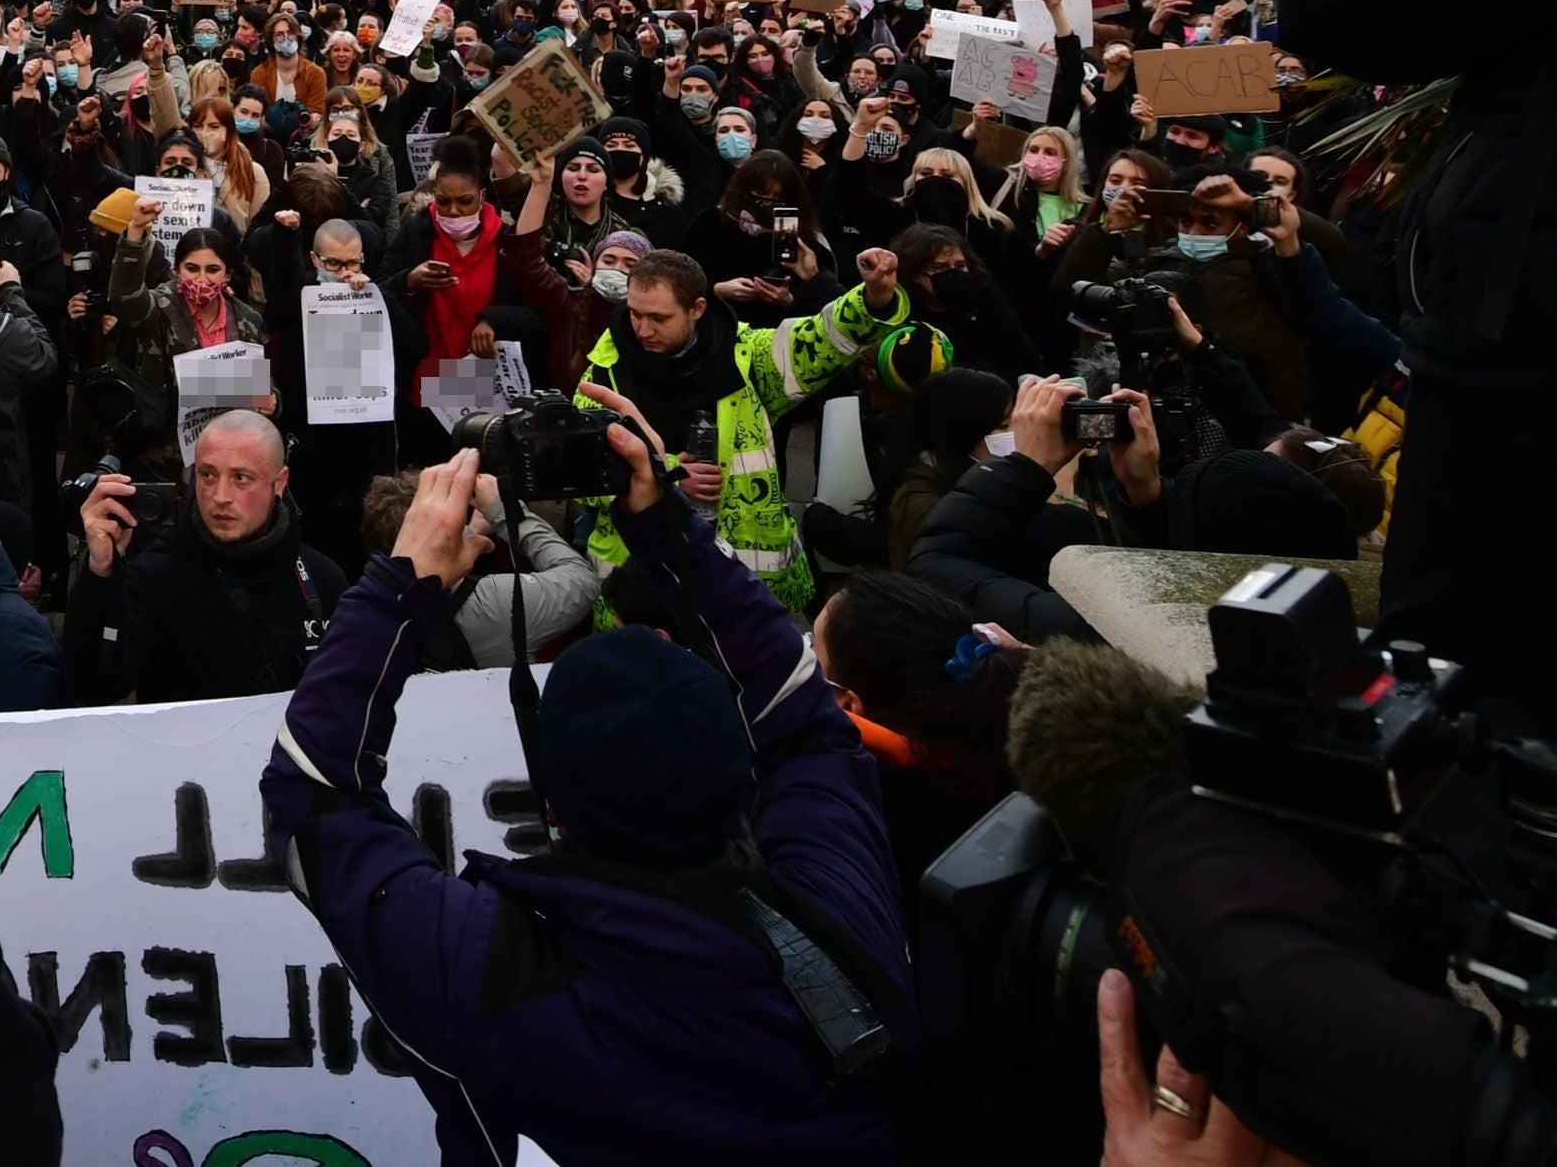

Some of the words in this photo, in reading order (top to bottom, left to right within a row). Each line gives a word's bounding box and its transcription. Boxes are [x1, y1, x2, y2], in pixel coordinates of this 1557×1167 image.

[933, 10, 955, 22] ONE
[975, 24, 991, 33] THE
[992, 25, 1017, 38] REST
[962, 37, 997, 70] AC
[957, 60, 997, 92] AB
[1153, 53, 1270, 106] ACAB
[408, 146, 430, 154] Tear
[411, 155, 427, 163] the
[172, 199, 206, 213] down
[163, 215, 202, 227] sexist
[151, 228, 182, 241] stem
[317, 293, 351, 302] Socialist
[498, 346, 512, 380] Tear
